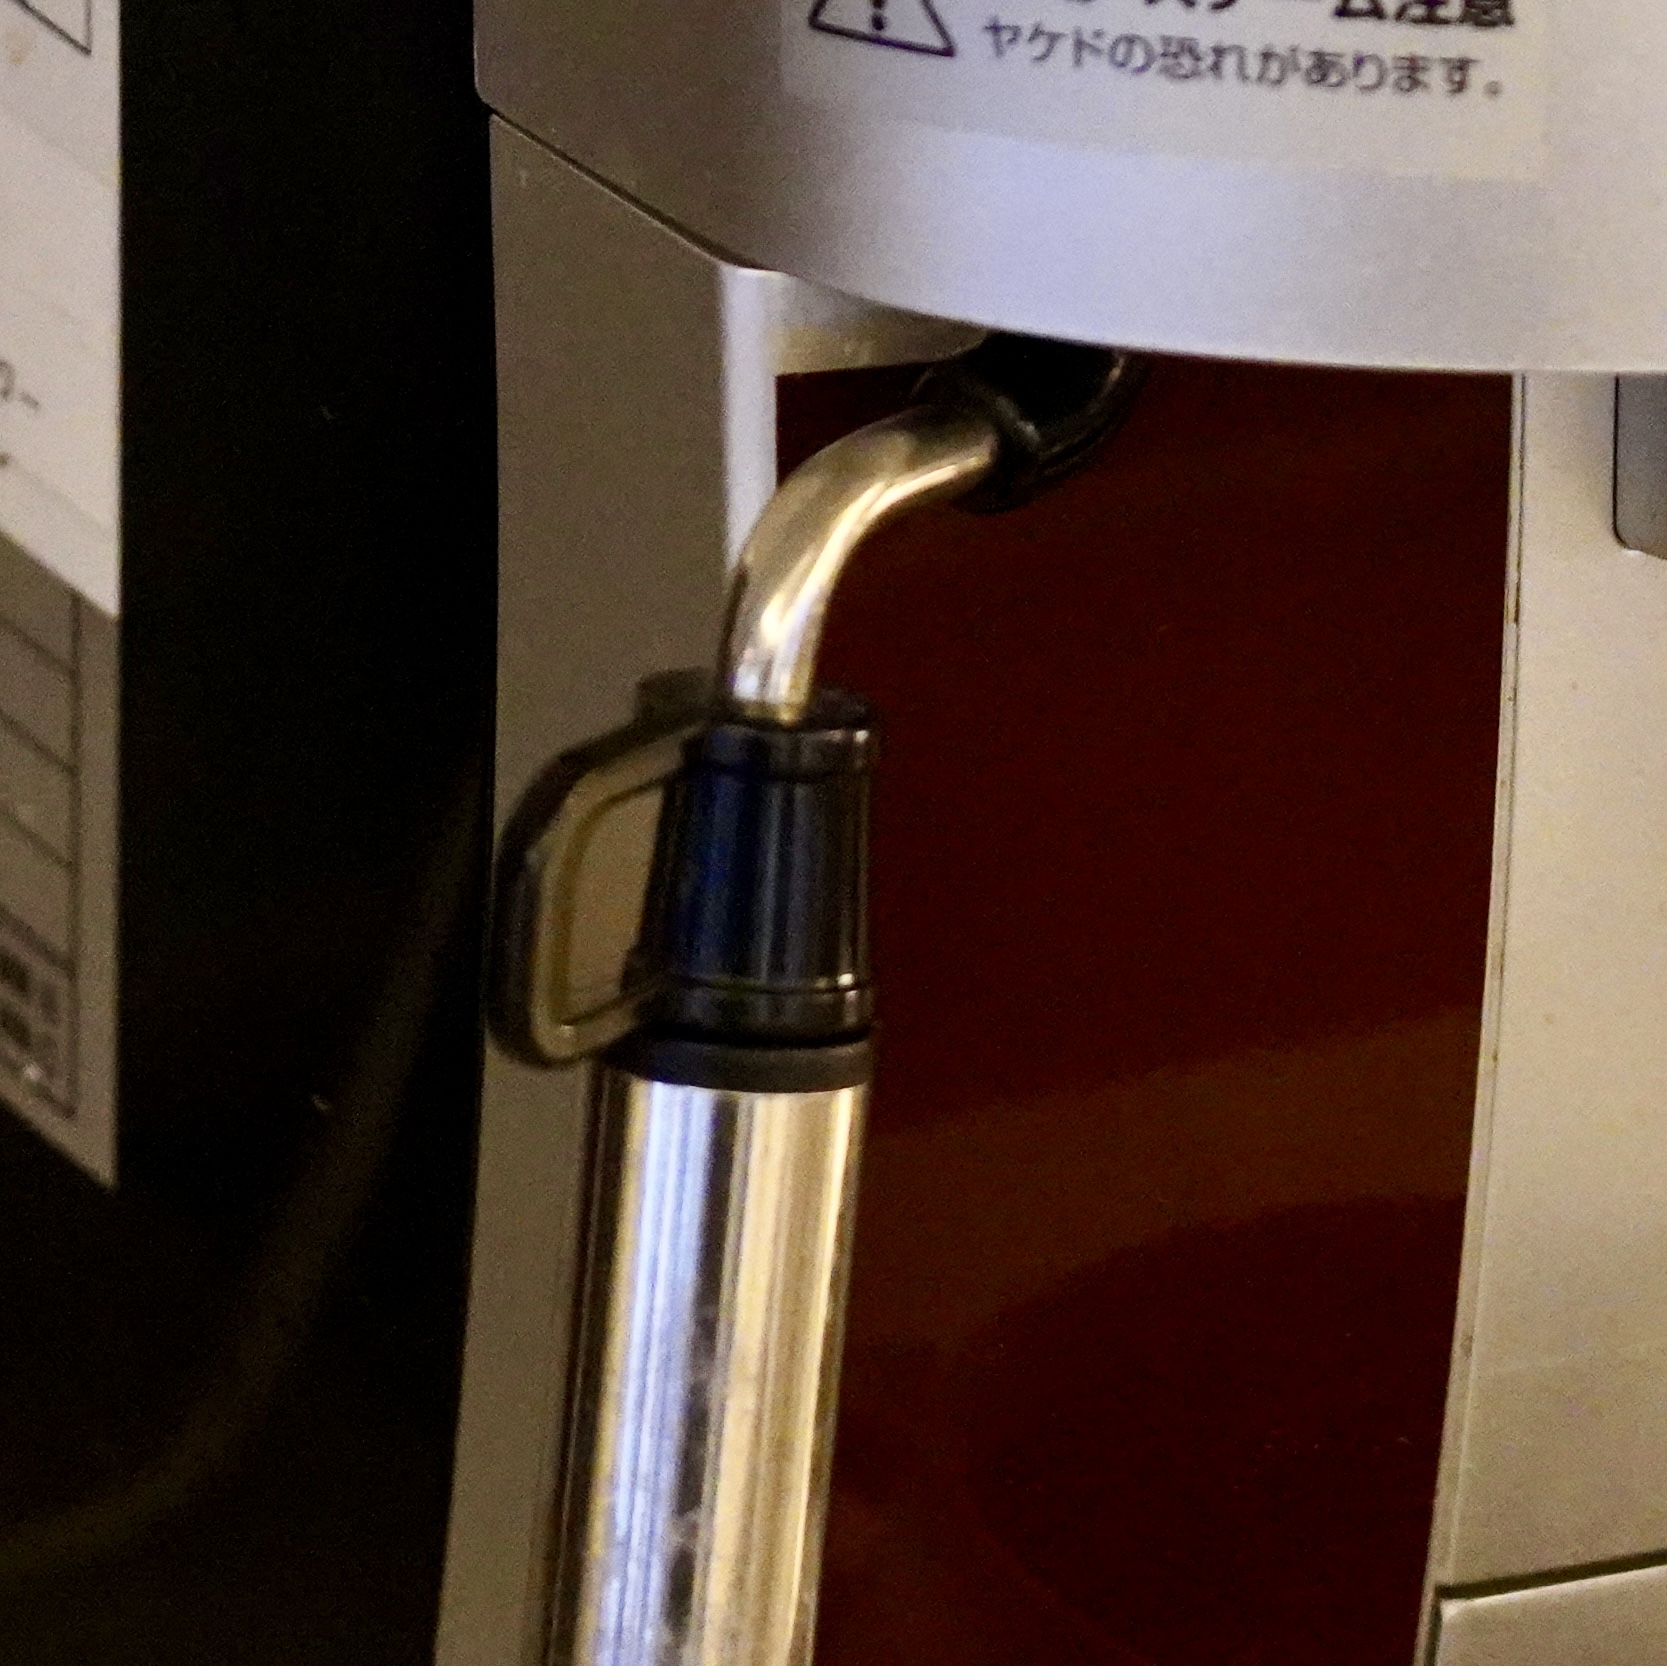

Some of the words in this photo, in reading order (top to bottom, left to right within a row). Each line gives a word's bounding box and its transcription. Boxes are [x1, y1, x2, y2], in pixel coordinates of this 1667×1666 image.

[983, 15, 1503, 97] ヤケドの恐れがあります。
